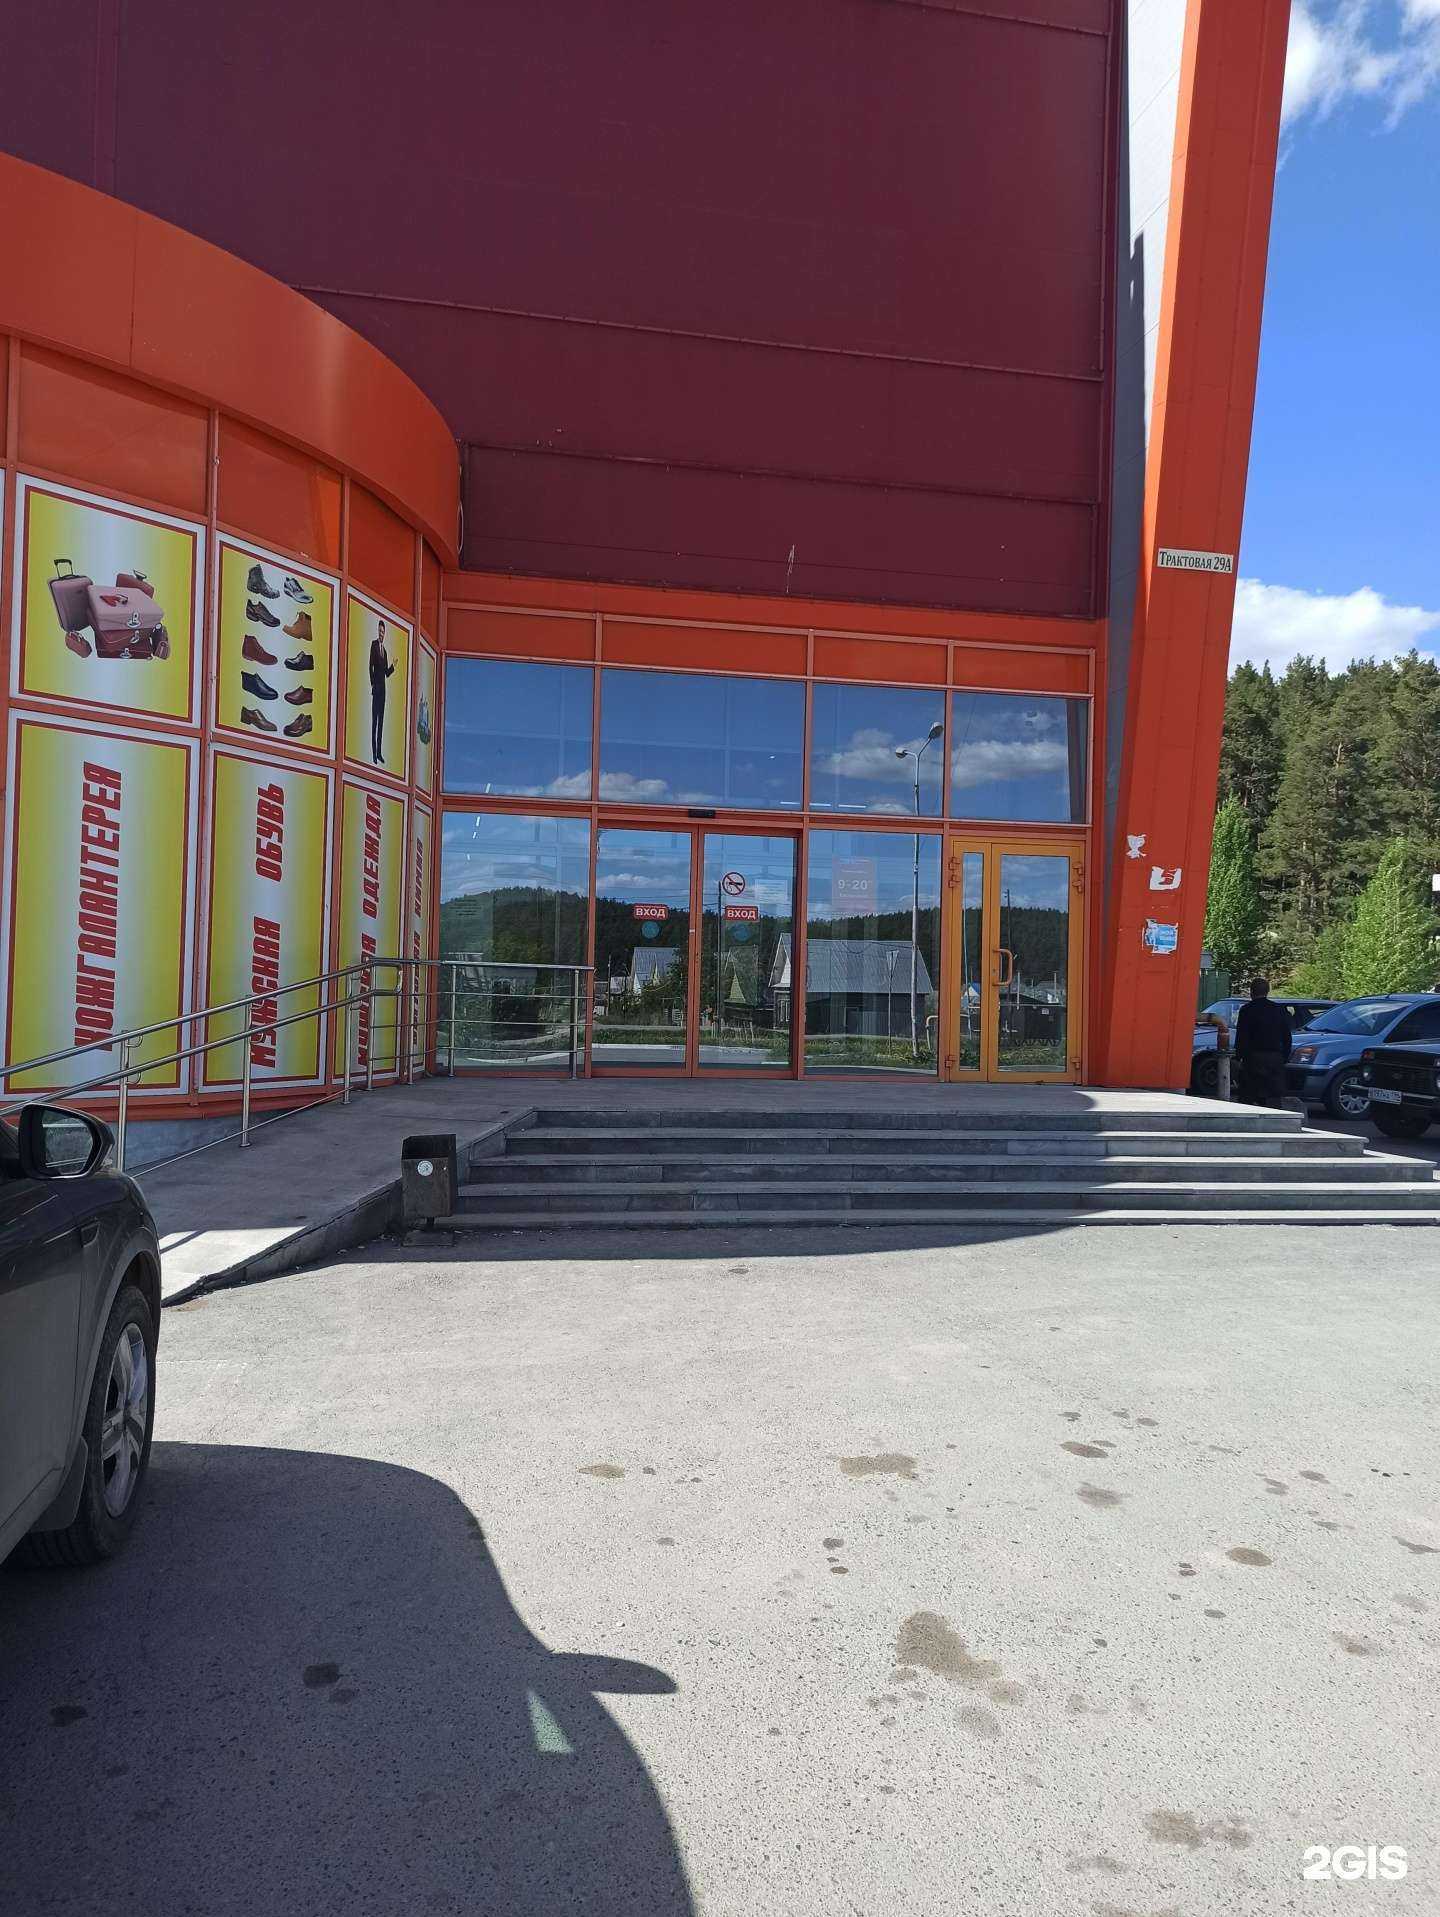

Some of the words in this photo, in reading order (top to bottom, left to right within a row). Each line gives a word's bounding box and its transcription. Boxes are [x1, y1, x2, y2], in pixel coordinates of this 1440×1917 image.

[1213, 556, 1232, 571] 29А
[255, 783, 284, 882] ОБУВЬ
[362, 793, 382, 919] ОДЕЖДА
[74, 761, 122, 1052] КОЖГАЛАНТЕРЕЯ
[635, 907, 666, 919] ВХОД
[727, 909, 757, 921] ВХОД
